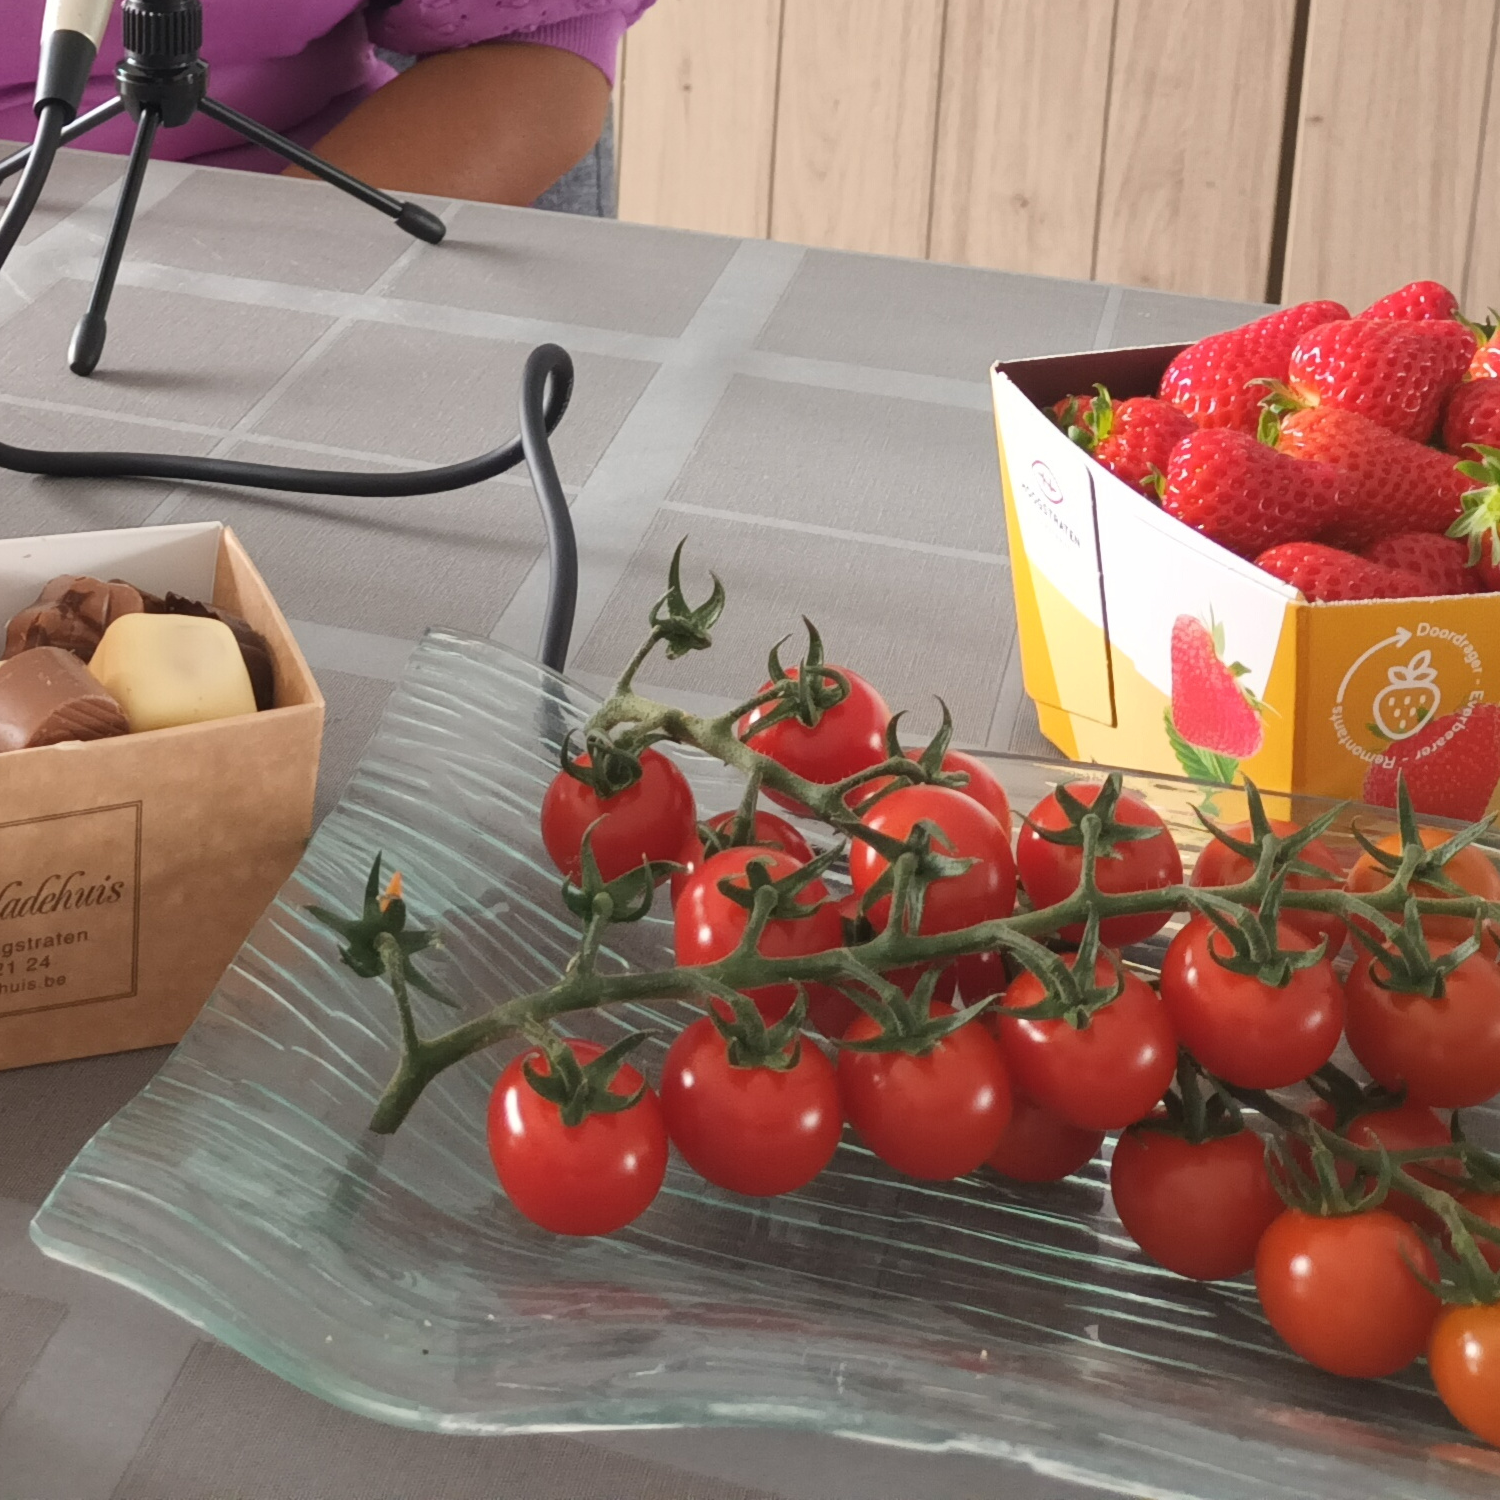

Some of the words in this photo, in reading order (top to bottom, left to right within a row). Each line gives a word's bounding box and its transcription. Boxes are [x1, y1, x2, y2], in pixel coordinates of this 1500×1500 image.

[1417, 622, 1483, 673] Doordrager
[1328, 705, 1397, 769] Remontants
[1415, 690, 1485, 760] Everbearer
[26, 955, 51, 972] 24
